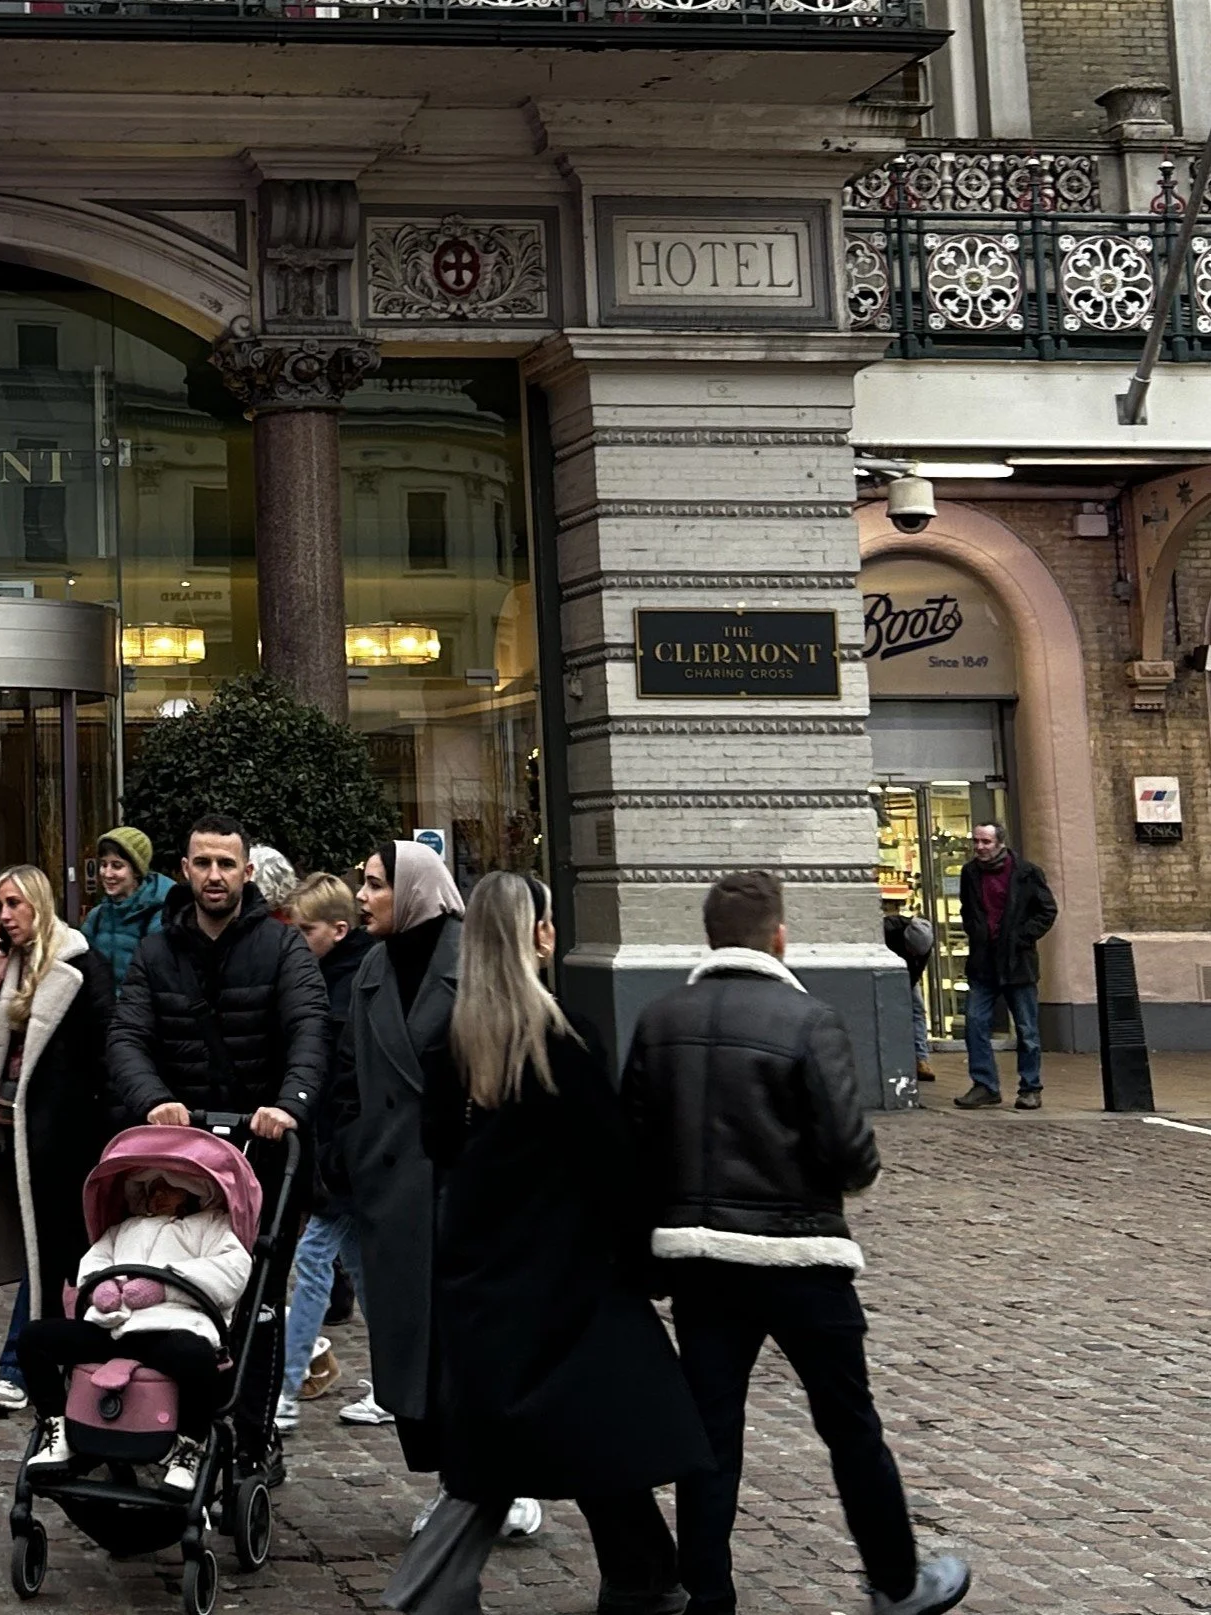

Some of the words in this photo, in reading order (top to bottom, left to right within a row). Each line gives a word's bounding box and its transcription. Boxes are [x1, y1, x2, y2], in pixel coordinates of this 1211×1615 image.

[635, 241, 795, 288] HOTEL
[722, 625, 754, 638] THE
[862, 592, 963, 660] Boots
[654, 642, 822, 664] CLERMONT
[928, 655, 959, 668] Since
[962, 655, 988, 668] 1849
[684, 668, 745, 679] CHARING
[750, 668, 794, 679] CROSS
